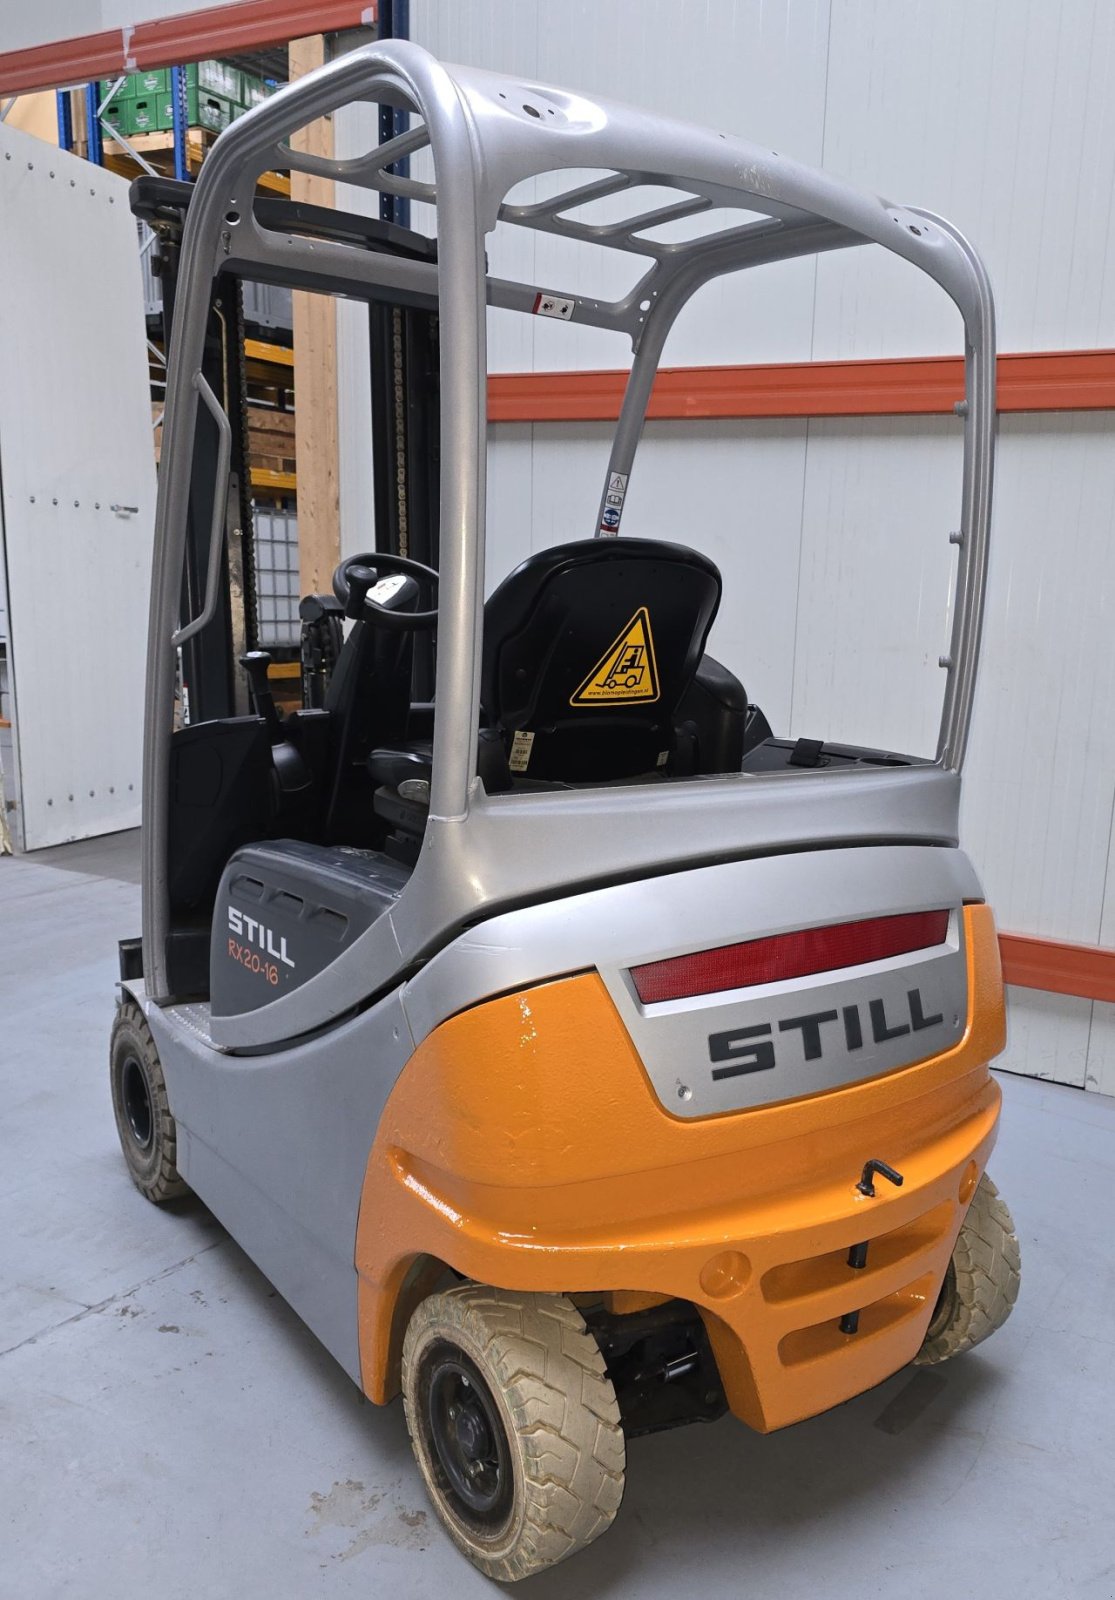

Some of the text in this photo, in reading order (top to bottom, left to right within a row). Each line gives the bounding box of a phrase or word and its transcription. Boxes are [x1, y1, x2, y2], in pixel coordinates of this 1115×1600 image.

[228, 905, 295, 968] STILL
[228, 937, 279, 985] RX20-16
[708, 988, 943, 1081] STILL
